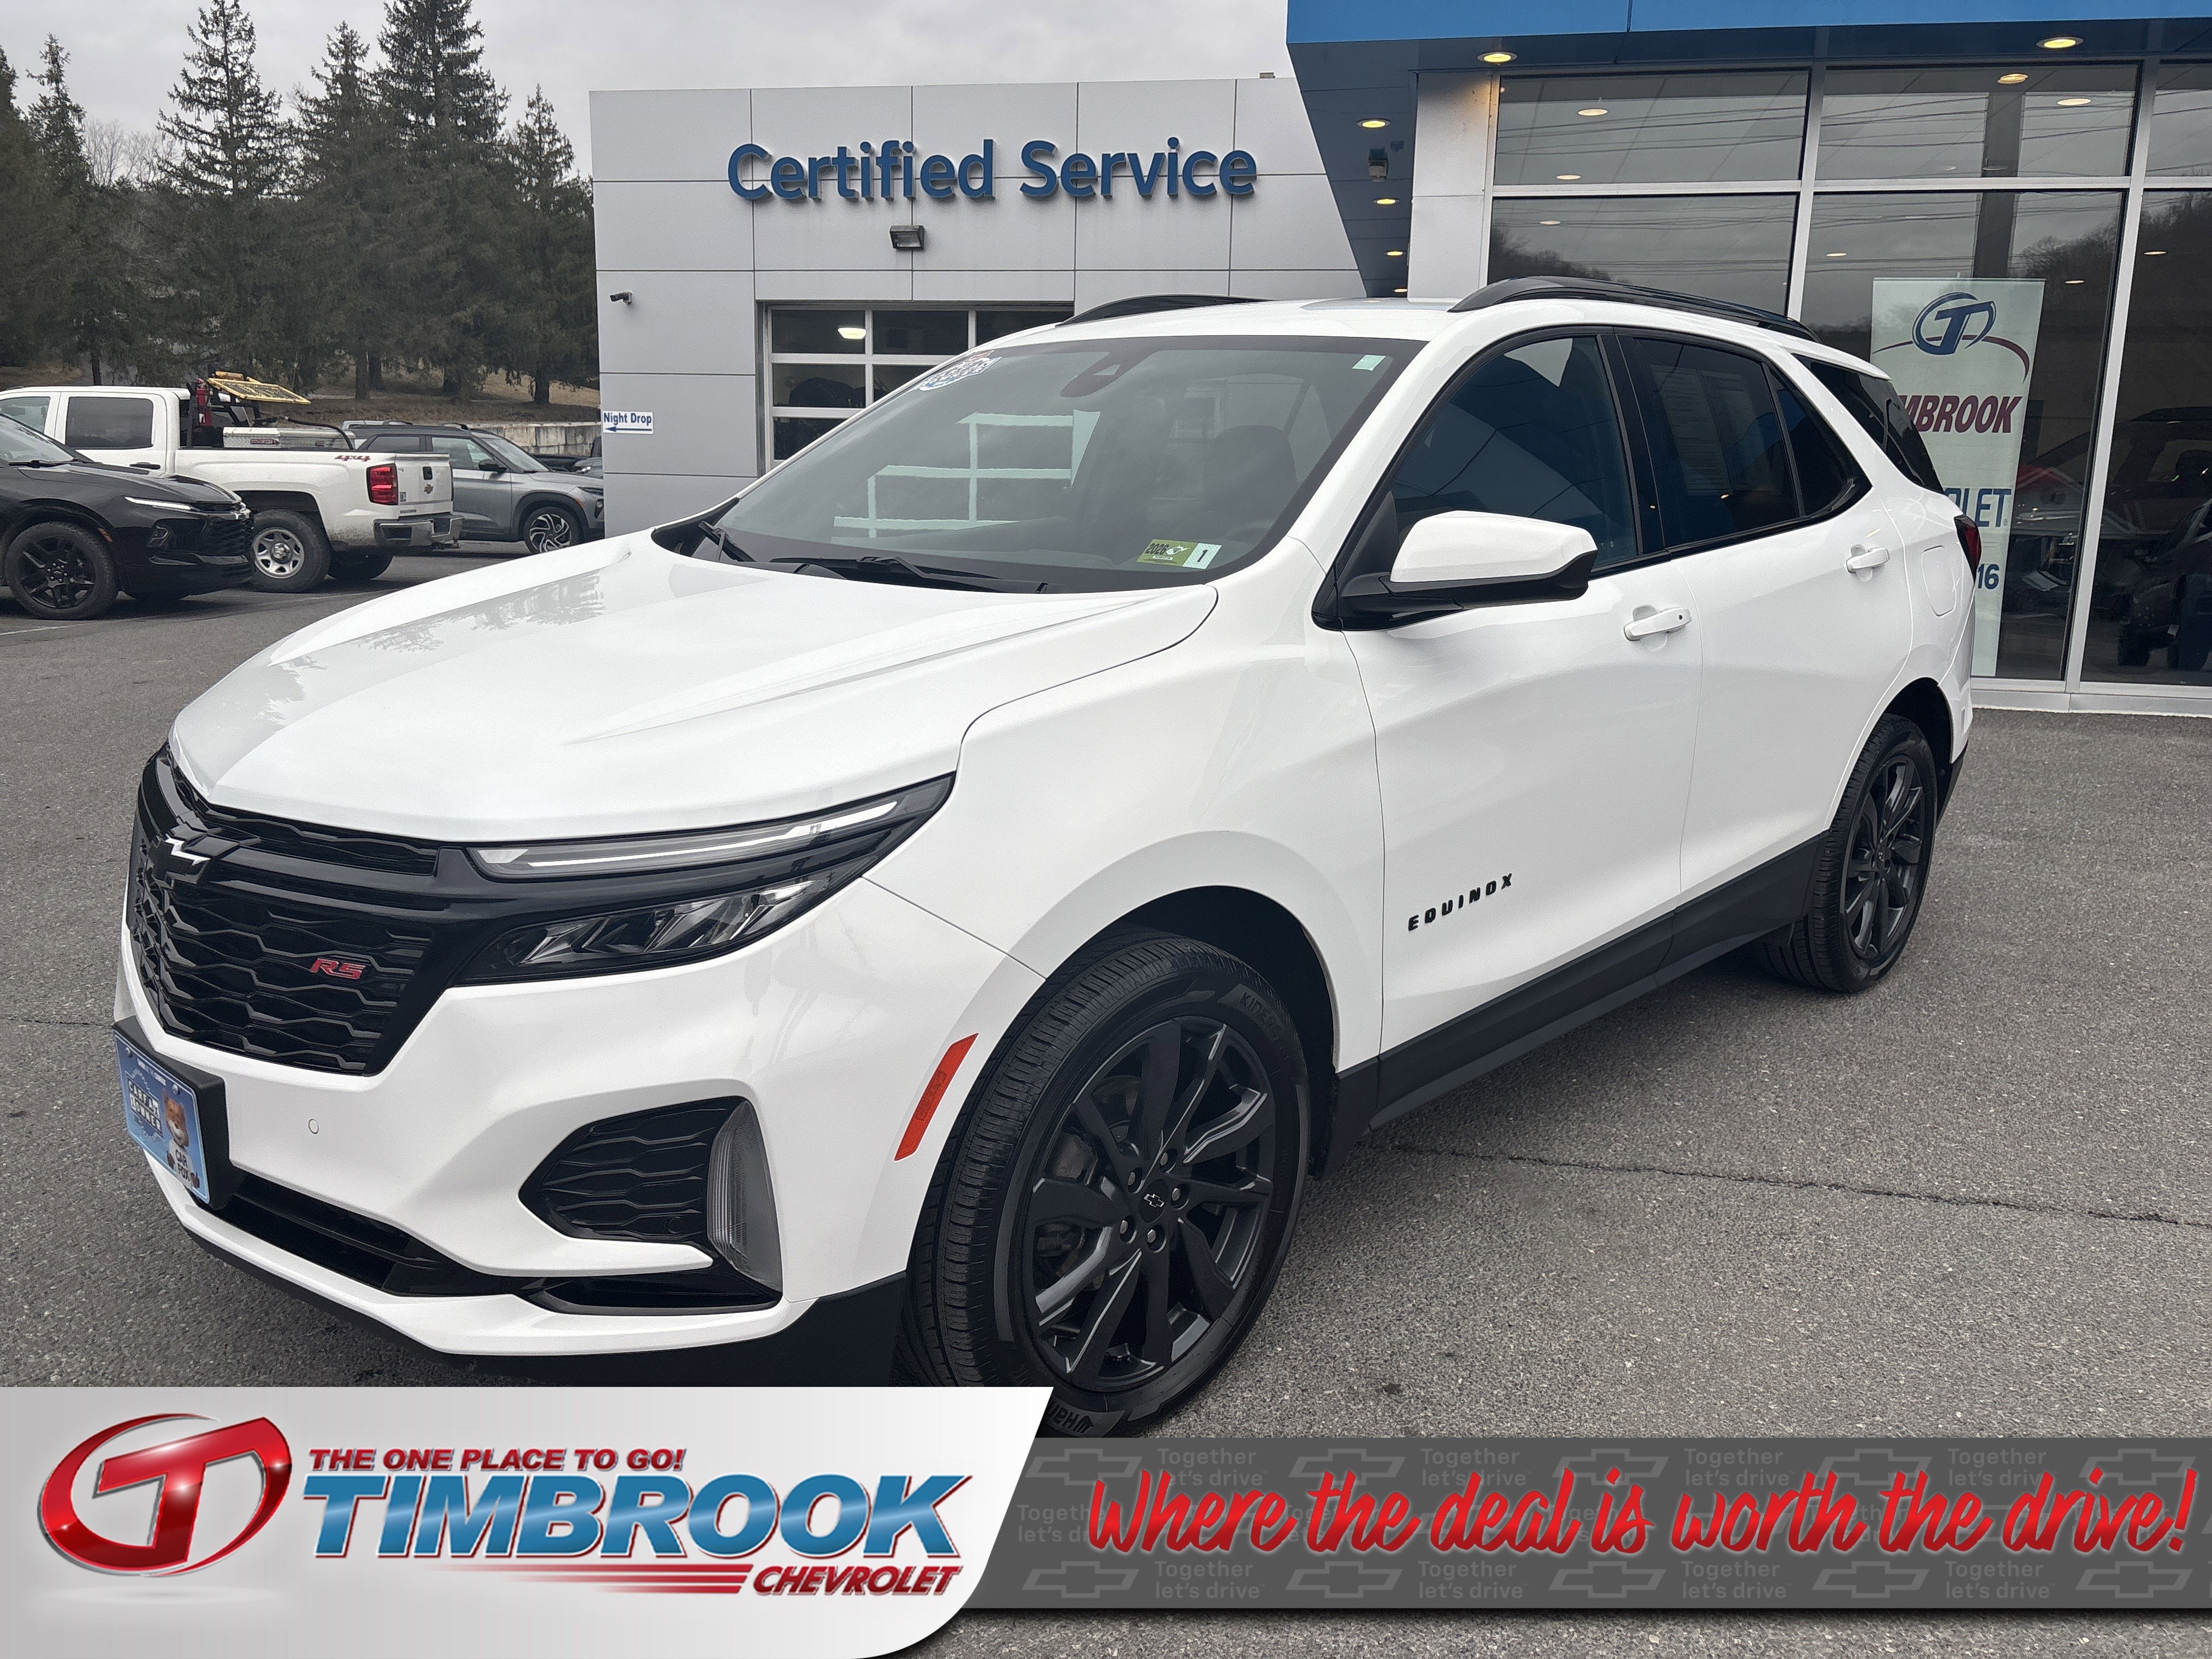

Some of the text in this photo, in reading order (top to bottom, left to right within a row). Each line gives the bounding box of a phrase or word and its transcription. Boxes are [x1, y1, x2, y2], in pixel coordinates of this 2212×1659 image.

[727, 137, 1257, 199] Certified Service
[603, 412, 652, 426] Night Drop
[1144, 543, 1170, 555] 2026
[1408, 873, 1513, 932] EQUINOX
[309, 956, 366, 980] RS
[127, 1077, 161, 1119] CARFAX
